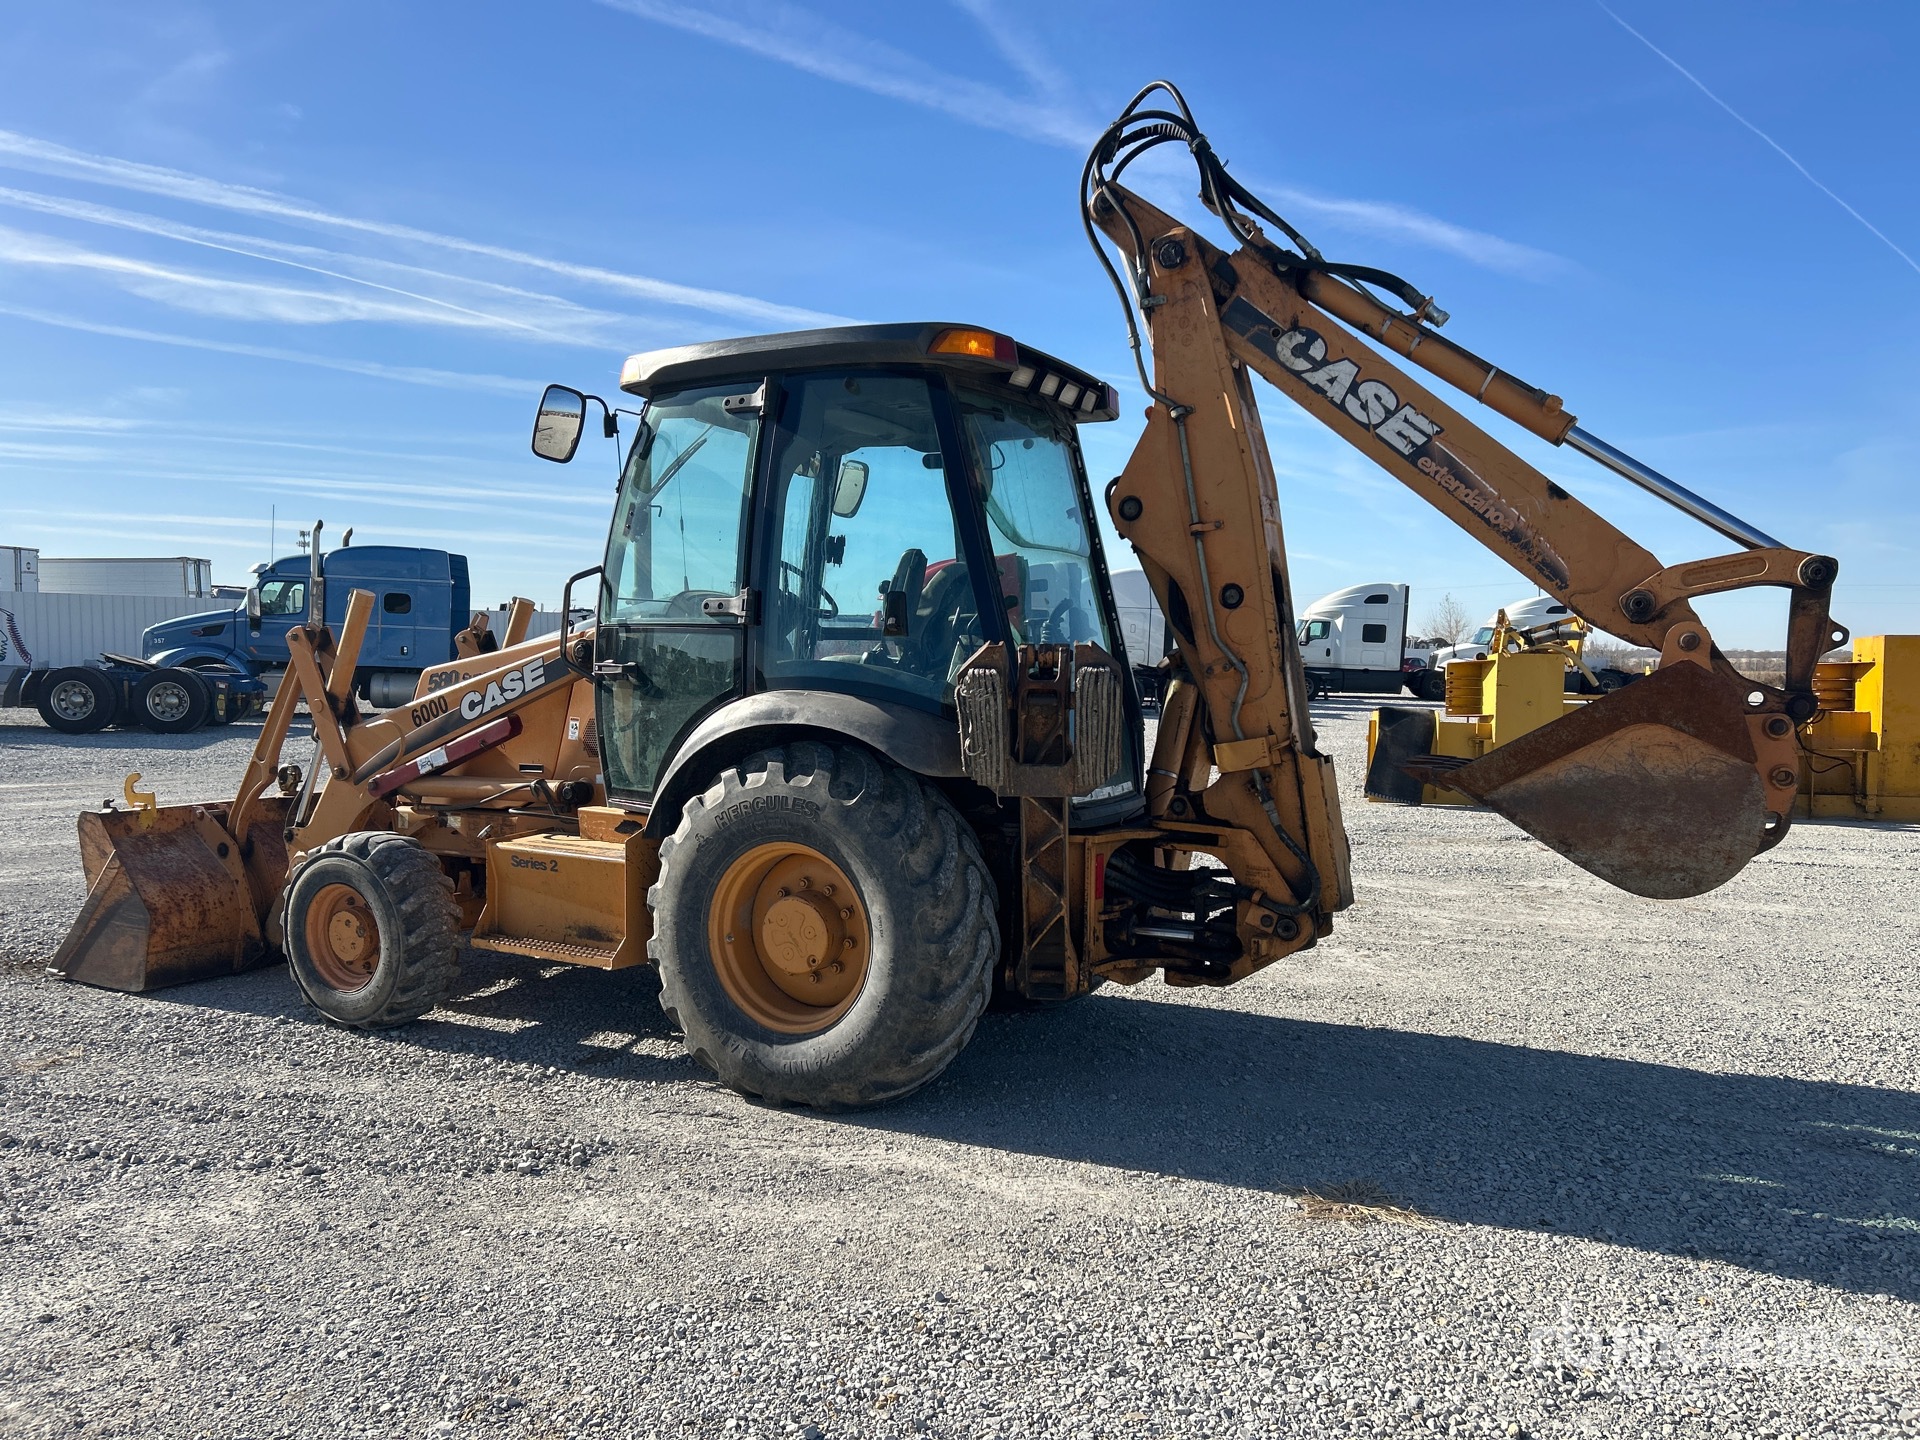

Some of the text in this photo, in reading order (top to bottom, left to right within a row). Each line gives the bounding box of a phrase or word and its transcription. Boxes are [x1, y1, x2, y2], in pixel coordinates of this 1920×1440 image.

[1274, 326, 1444, 457] CASE
[428, 669, 460, 694] 580
[460, 657, 546, 720] CASE
[411, 695, 449, 728] 6000
[714, 795, 821, 830] HERCULES
[511, 854, 559, 872] Series 2
